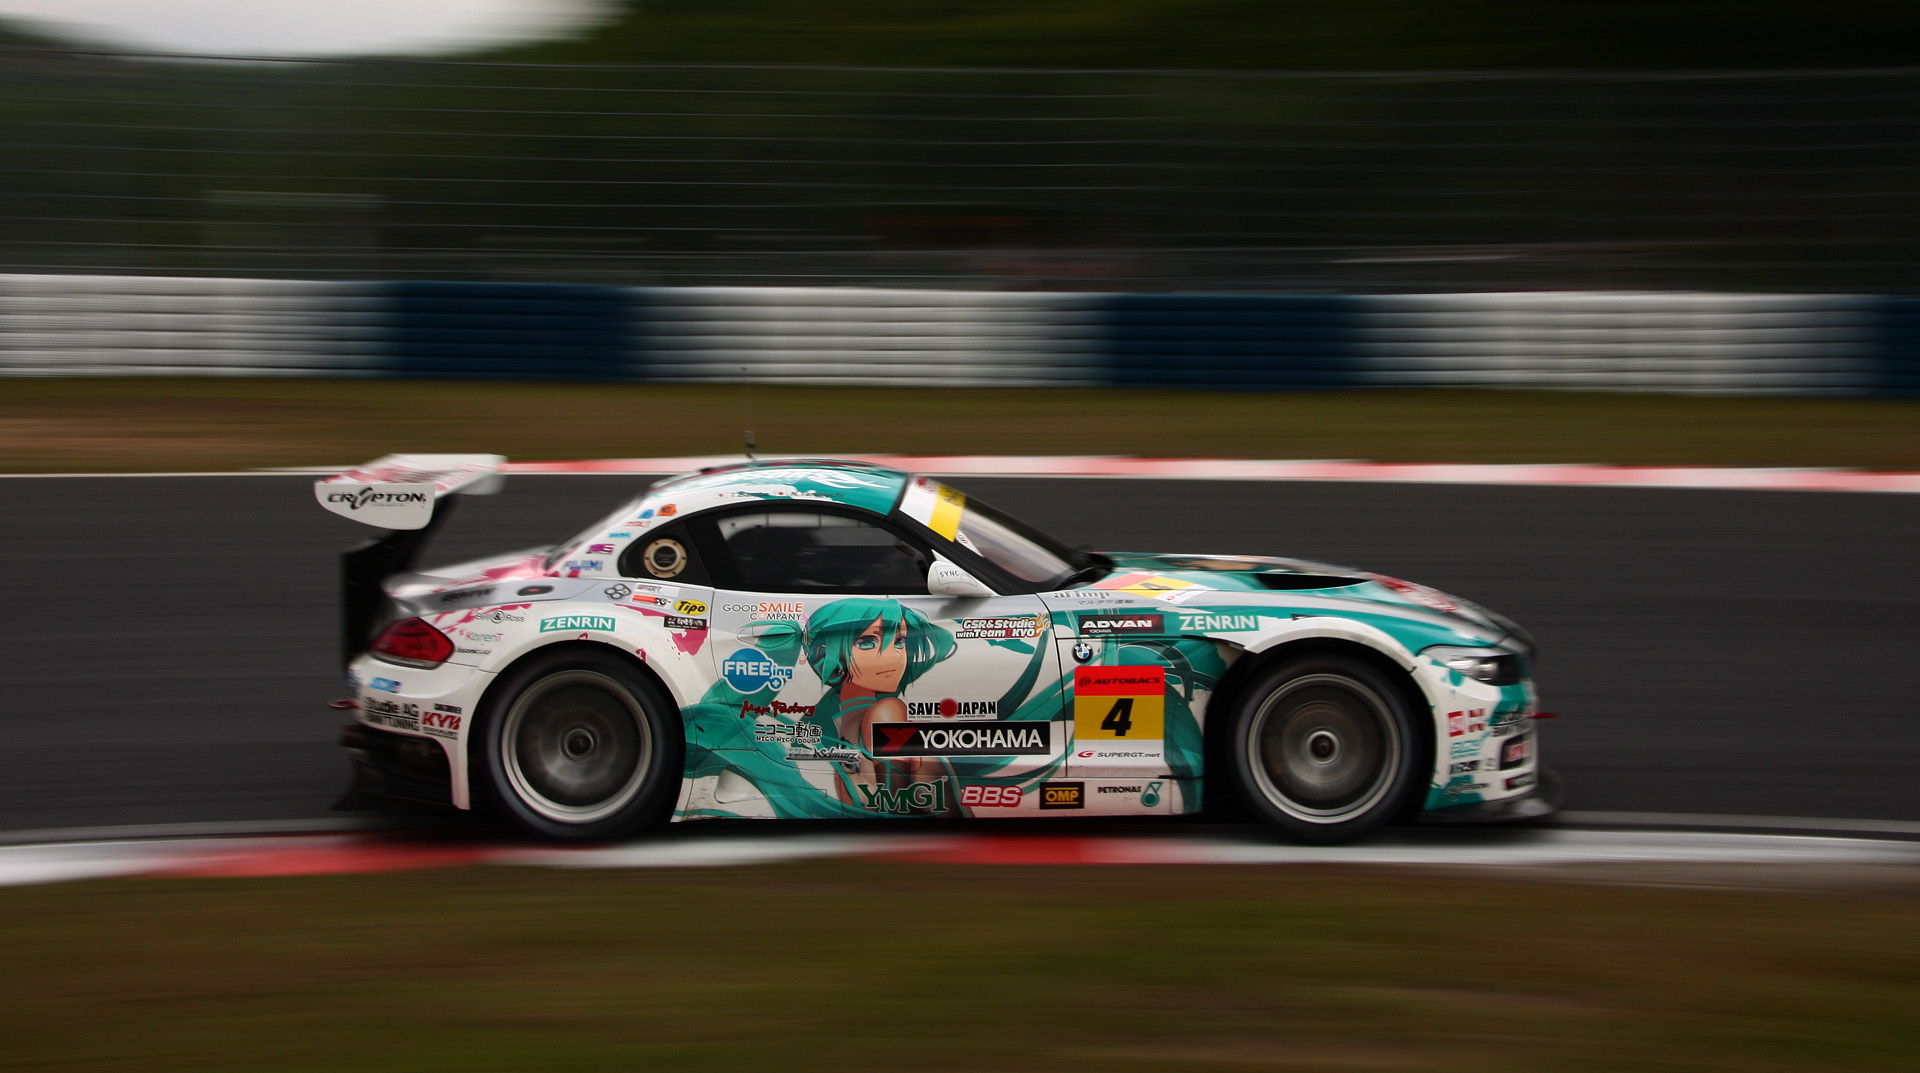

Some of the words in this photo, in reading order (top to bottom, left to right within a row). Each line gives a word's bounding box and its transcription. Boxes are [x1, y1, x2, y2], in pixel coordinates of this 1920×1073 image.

[677, 600, 706, 615] Tipo
[722, 604, 758, 612] GOOD
[759, 602, 802, 613] SMILE
[750, 612, 802, 620] COMPANY
[543, 618, 614, 631] ZENRIN
[1082, 620, 1153, 629] ADVAN
[1180, 615, 1258, 632] ZENRIN
[908, 702, 941, 715] SAVE
[956, 701, 996, 715] JAPAN
[1101, 698, 1134, 737] 4
[755, 722, 820, 737] ニコニコ動画
[919, 729, 1044, 749] YOKOHAMA
[961, 787, 1021, 804] BBS
[1045, 789, 1079, 802] OMP
[1097, 786, 1142, 794] PETRONAS
